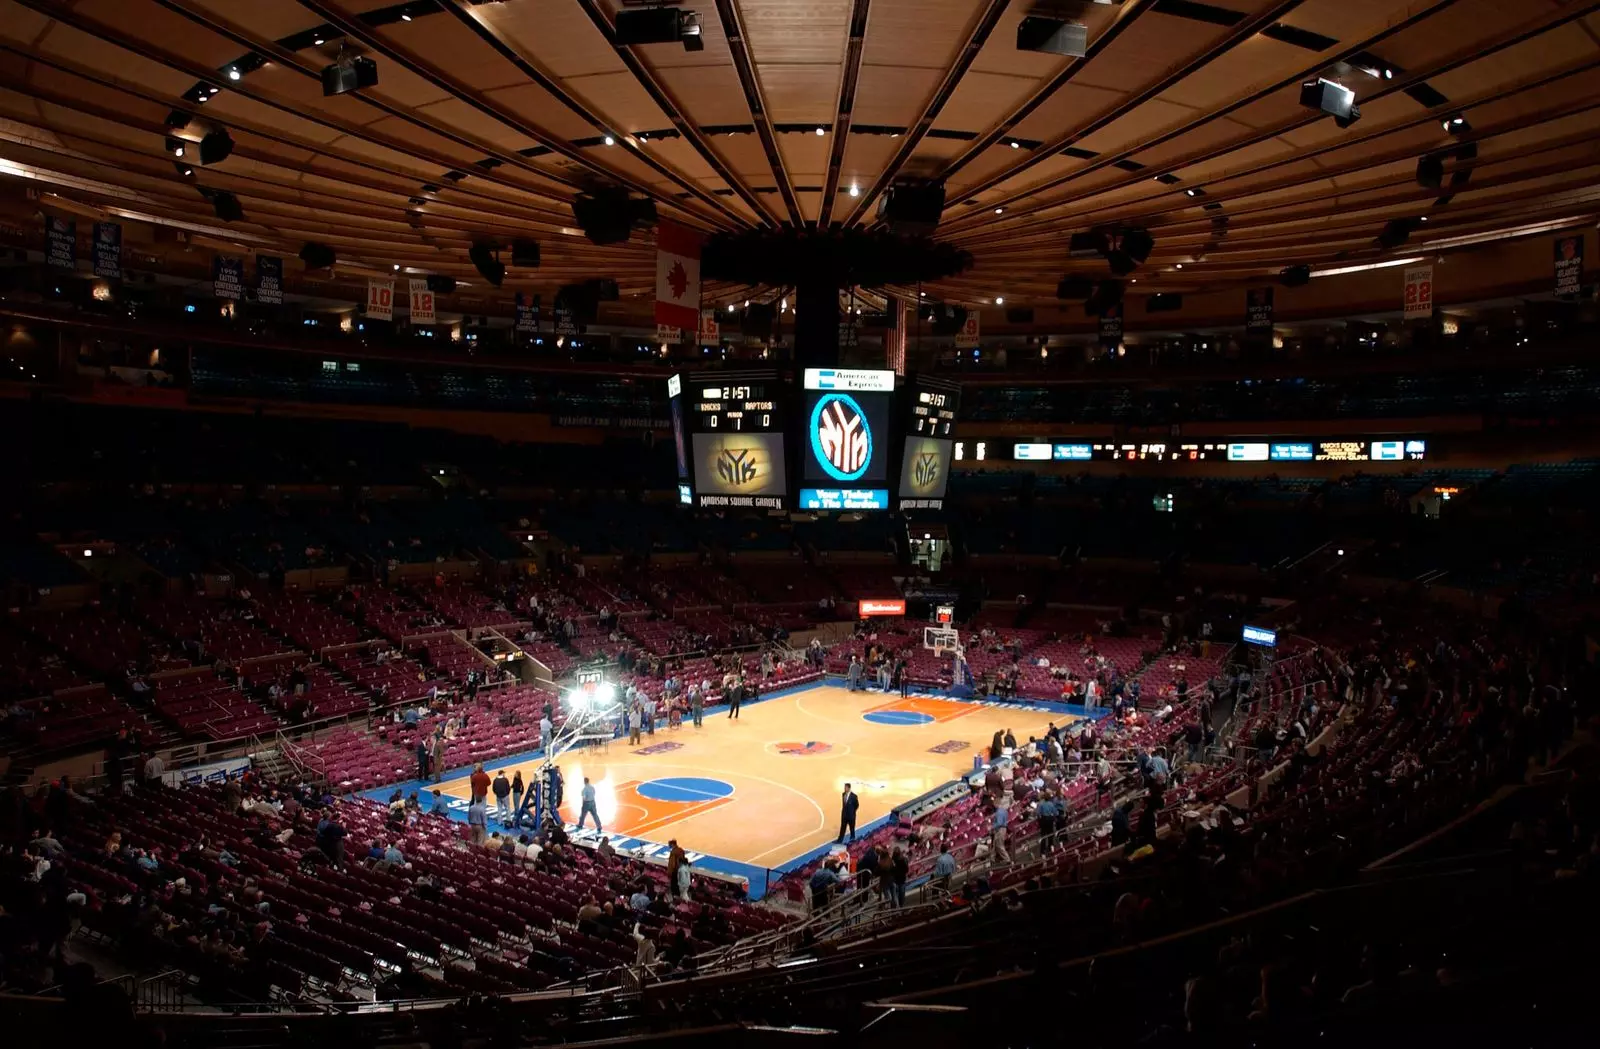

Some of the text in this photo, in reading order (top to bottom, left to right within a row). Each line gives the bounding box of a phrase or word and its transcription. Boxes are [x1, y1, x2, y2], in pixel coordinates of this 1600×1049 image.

[370, 287, 390, 306] 10
[1405, 281, 1431, 304] 22
[412, 292, 433, 311] 12
[711, 415, 717, 427] 0
[737, 418, 741, 430] 1
[763, 414, 770, 427] 0
[700, 496, 782, 509] MADISON SQUARE GARDEN
